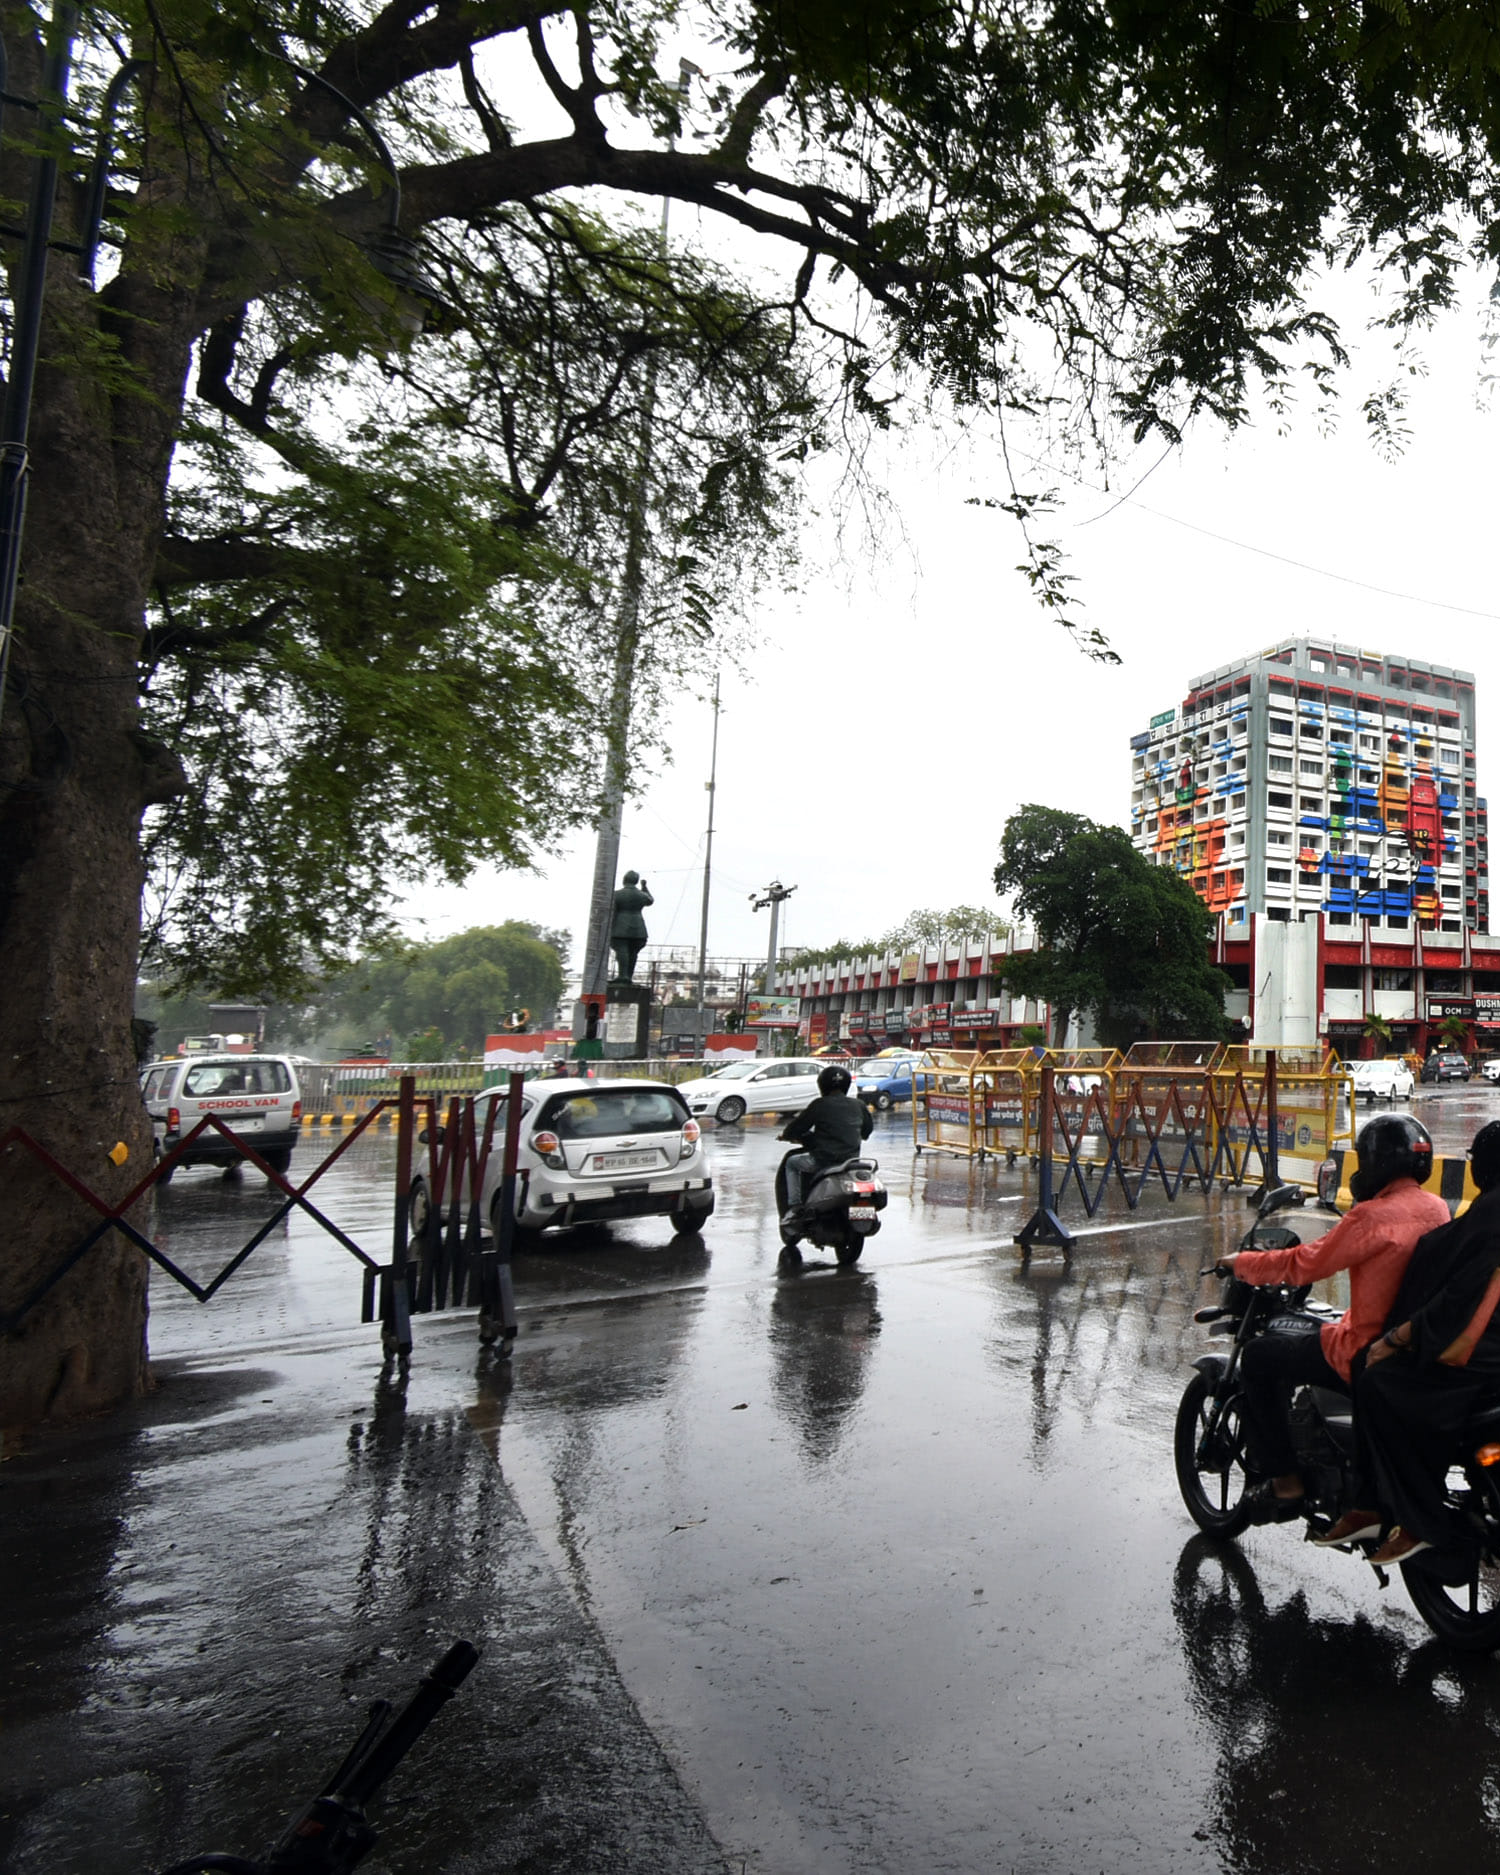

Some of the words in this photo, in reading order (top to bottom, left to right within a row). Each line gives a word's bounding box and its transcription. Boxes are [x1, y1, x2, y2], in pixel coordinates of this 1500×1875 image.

[1445, 1007, 1462, 1015] OCM
[198, 1100, 252, 1110] SCHOOL
[254, 1098, 280, 1107] VAN
